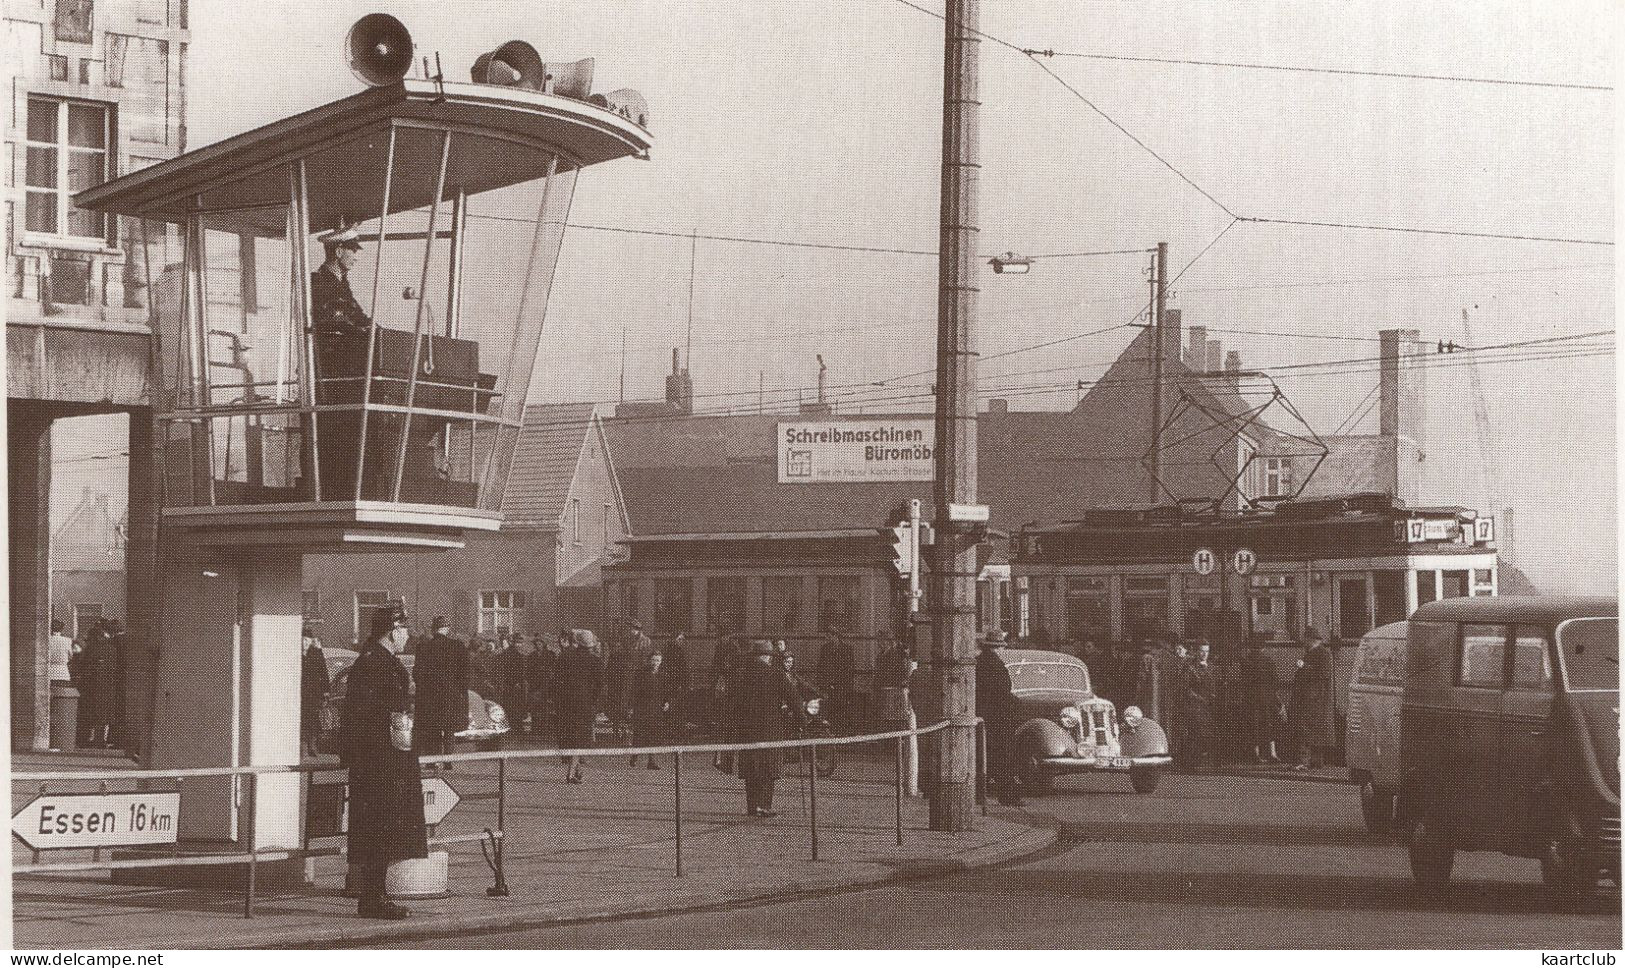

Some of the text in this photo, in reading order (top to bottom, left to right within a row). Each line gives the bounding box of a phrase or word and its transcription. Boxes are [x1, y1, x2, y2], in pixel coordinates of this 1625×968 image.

[785, 427, 923, 443] Schreibmaschinen
[1411, 522, 1423, 539] 17
[1479, 521, 1490, 538] 17
[39, 803, 171, 835] Essen 16 km
